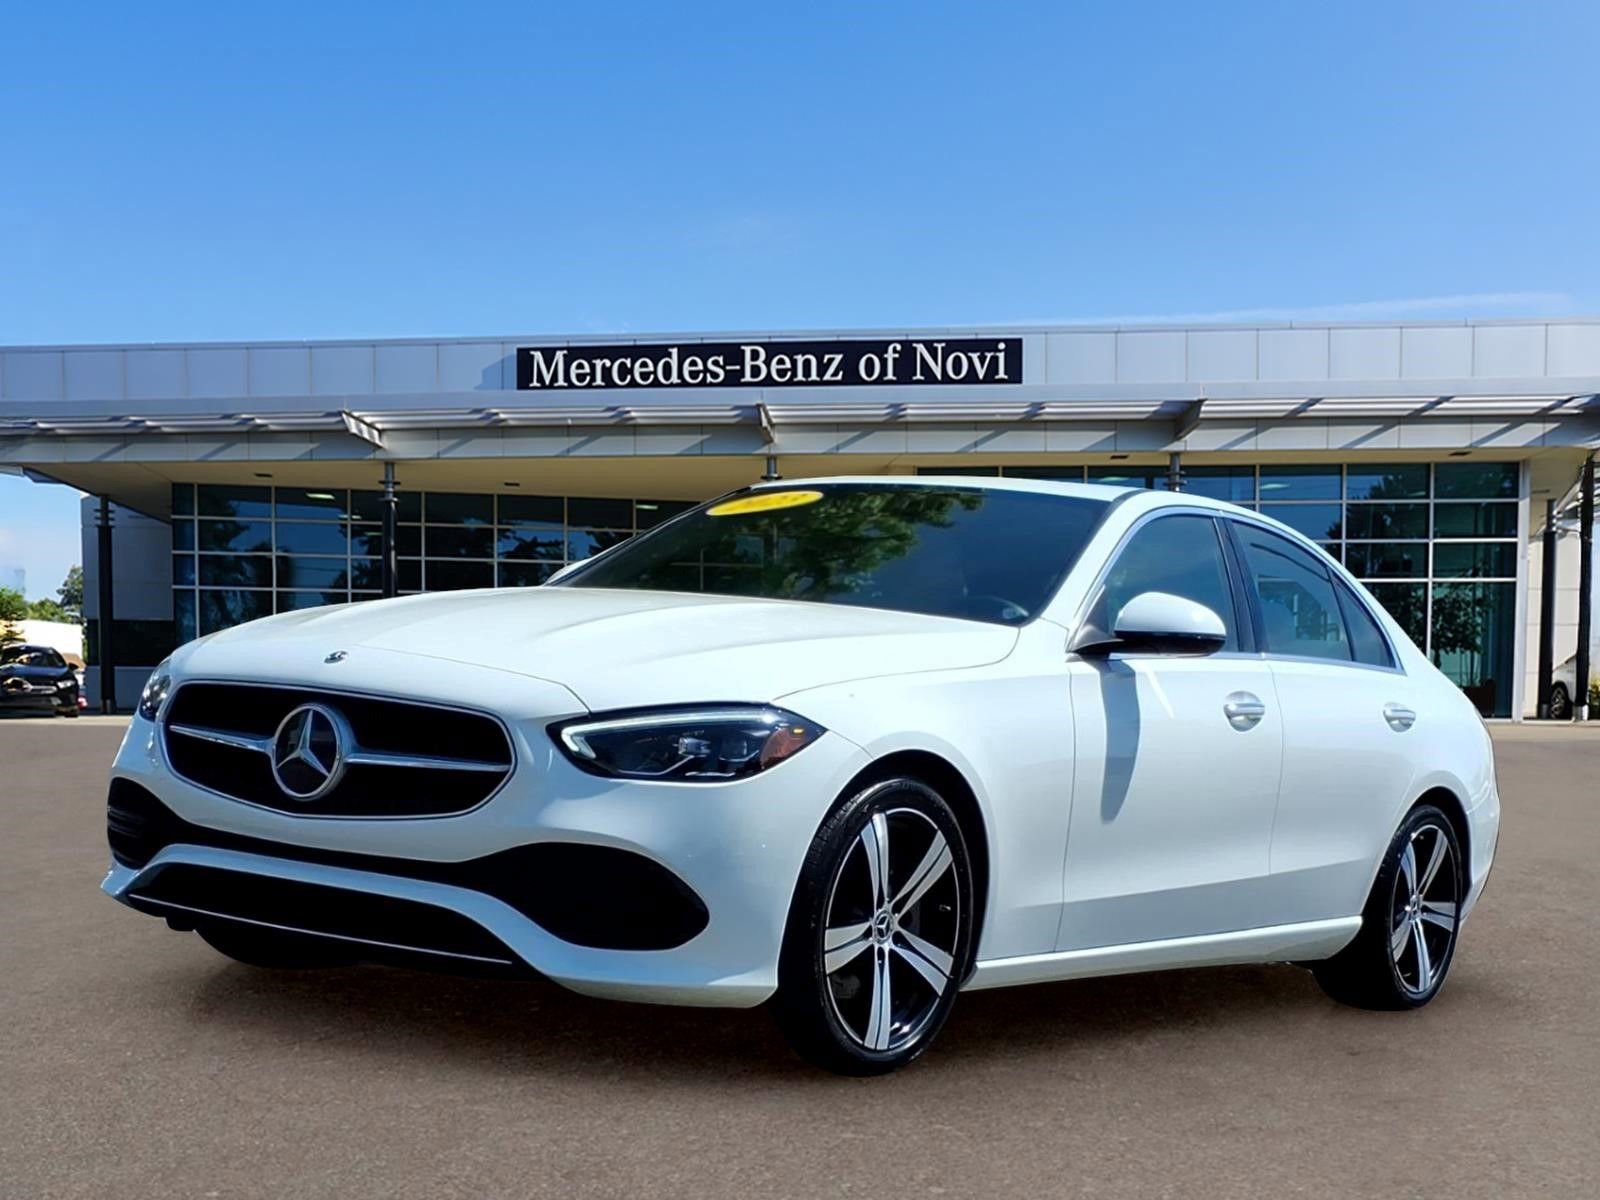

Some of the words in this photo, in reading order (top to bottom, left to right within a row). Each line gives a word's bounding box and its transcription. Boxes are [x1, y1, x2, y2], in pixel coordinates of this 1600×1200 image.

[529, 345, 844, 388] Mercedes-Benz
[858, 343, 901, 381] of
[912, 342, 1009, 381] Novi
